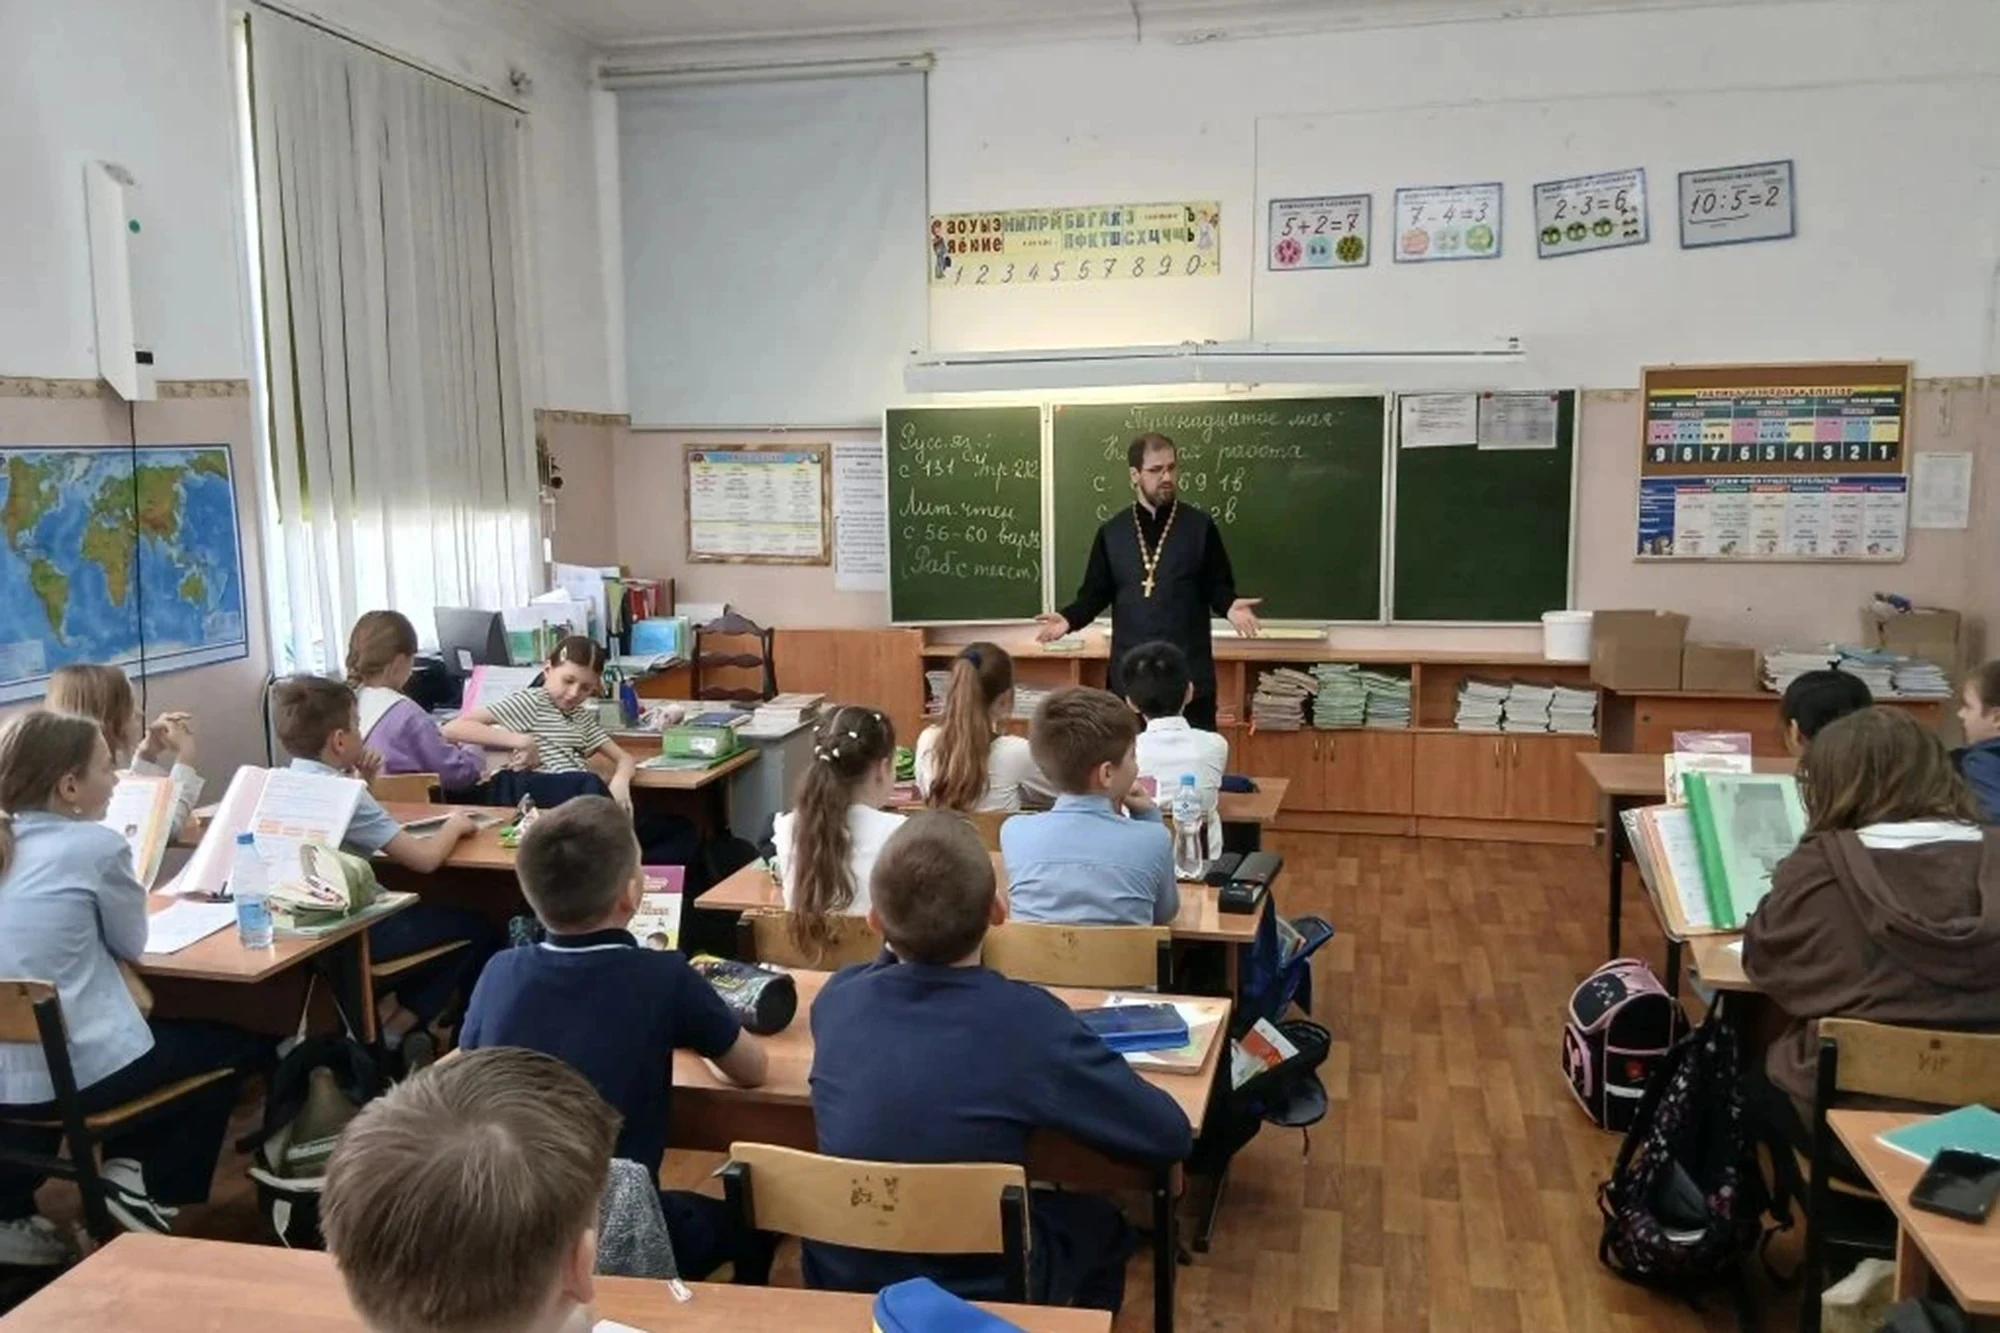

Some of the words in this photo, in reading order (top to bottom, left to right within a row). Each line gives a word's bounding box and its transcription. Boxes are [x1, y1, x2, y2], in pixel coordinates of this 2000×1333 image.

[975, 264, 989, 285] 2
[1001, 263, 1015, 283] 3
[1050, 260, 1065, 281] 5
[1103, 258, 1118, 278] 7
[1132, 256, 1145, 278] 8
[1158, 255, 1172, 276] 9
[1185, 254, 1201, 276] 0
[1656, 447, 1665, 461] 9
[1682, 447, 1692, 461] 8
[1710, 447, 1721, 461] 7
[1739, 446, 1749, 460] 6
[1765, 445, 1775, 460] 5
[1793, 445, 1804, 459] 4
[1822, 445, 1832, 459] 3
[1850, 445, 1859, 459] 2
[1880, 445, 1887, 459] 1
